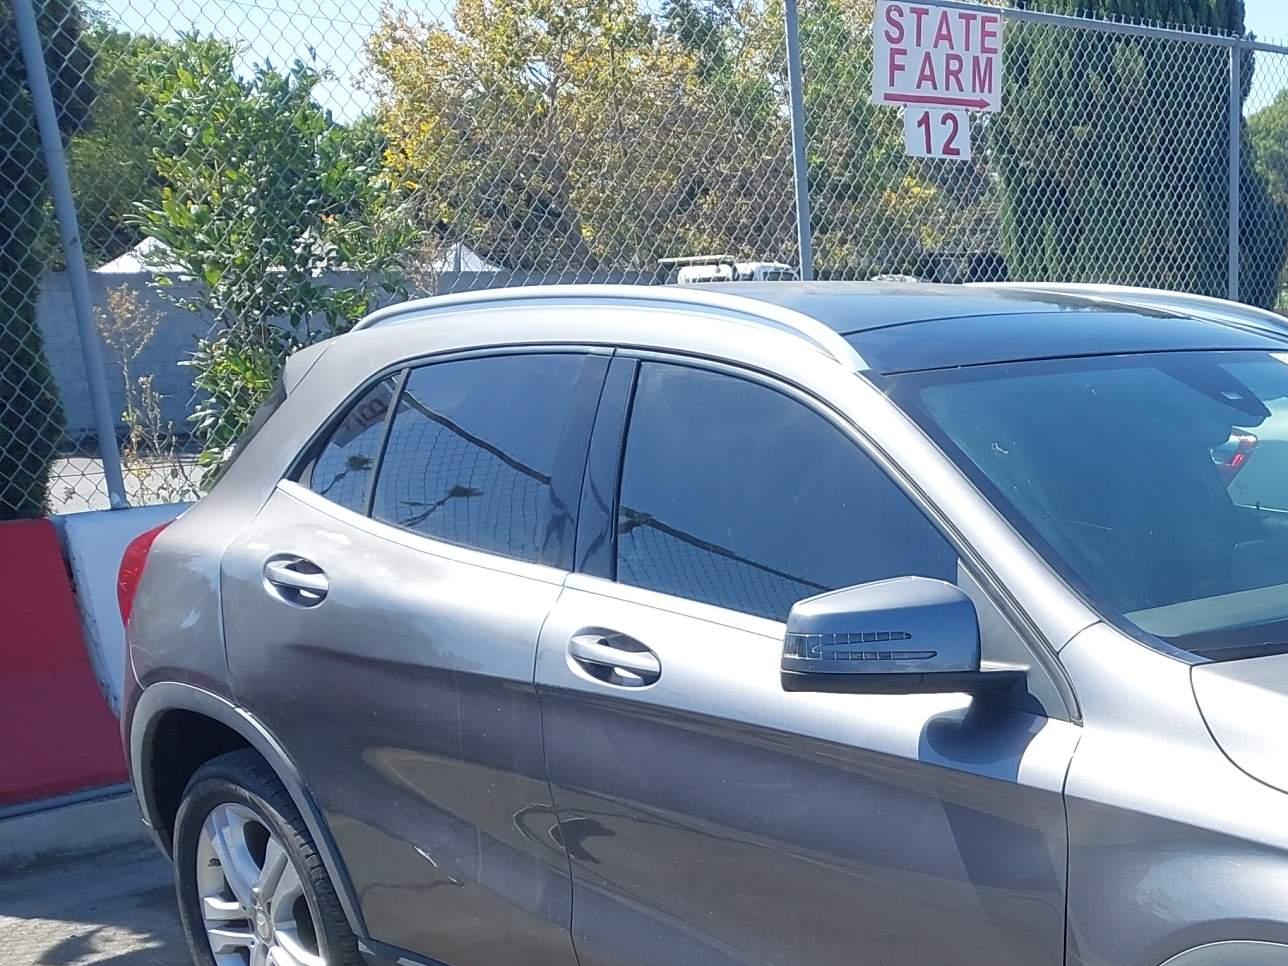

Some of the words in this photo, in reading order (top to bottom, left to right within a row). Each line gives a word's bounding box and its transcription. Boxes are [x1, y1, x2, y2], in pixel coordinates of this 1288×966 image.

[884, 4, 999, 54] STATE
[888, 47, 993, 94] FARM
[916, 111, 961, 156] 12
